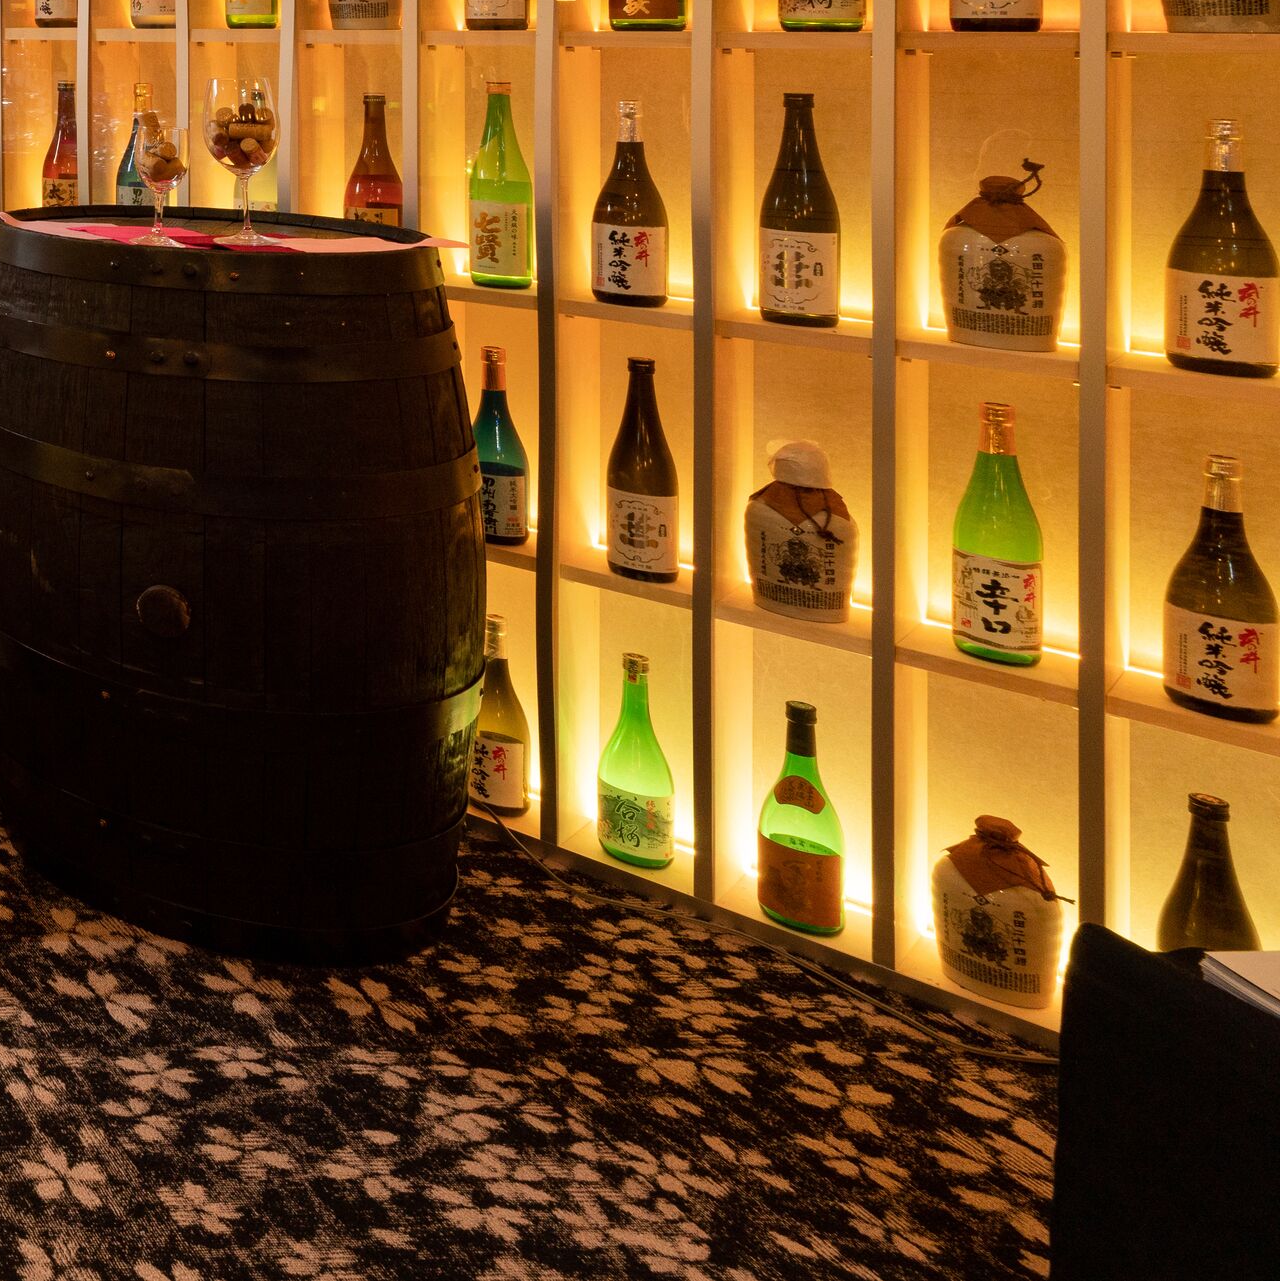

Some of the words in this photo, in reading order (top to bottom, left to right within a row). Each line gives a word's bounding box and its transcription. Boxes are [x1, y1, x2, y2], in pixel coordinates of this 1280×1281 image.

[474, 210, 502, 264] 七賢
[607, 230, 634, 291] 純米吟醸
[633, 230, 652, 268] 武の井
[1196, 279, 1237, 356] 純米吟醸
[1237, 281, 1263, 328] 武の井
[974, 578, 1020, 635] 辛口
[1023, 573, 1037, 609] 武の井
[1196, 620, 1237, 700] 純米吟醸
[1238, 627, 1263, 674] 武の井
[491, 744, 510, 781] 武の井
